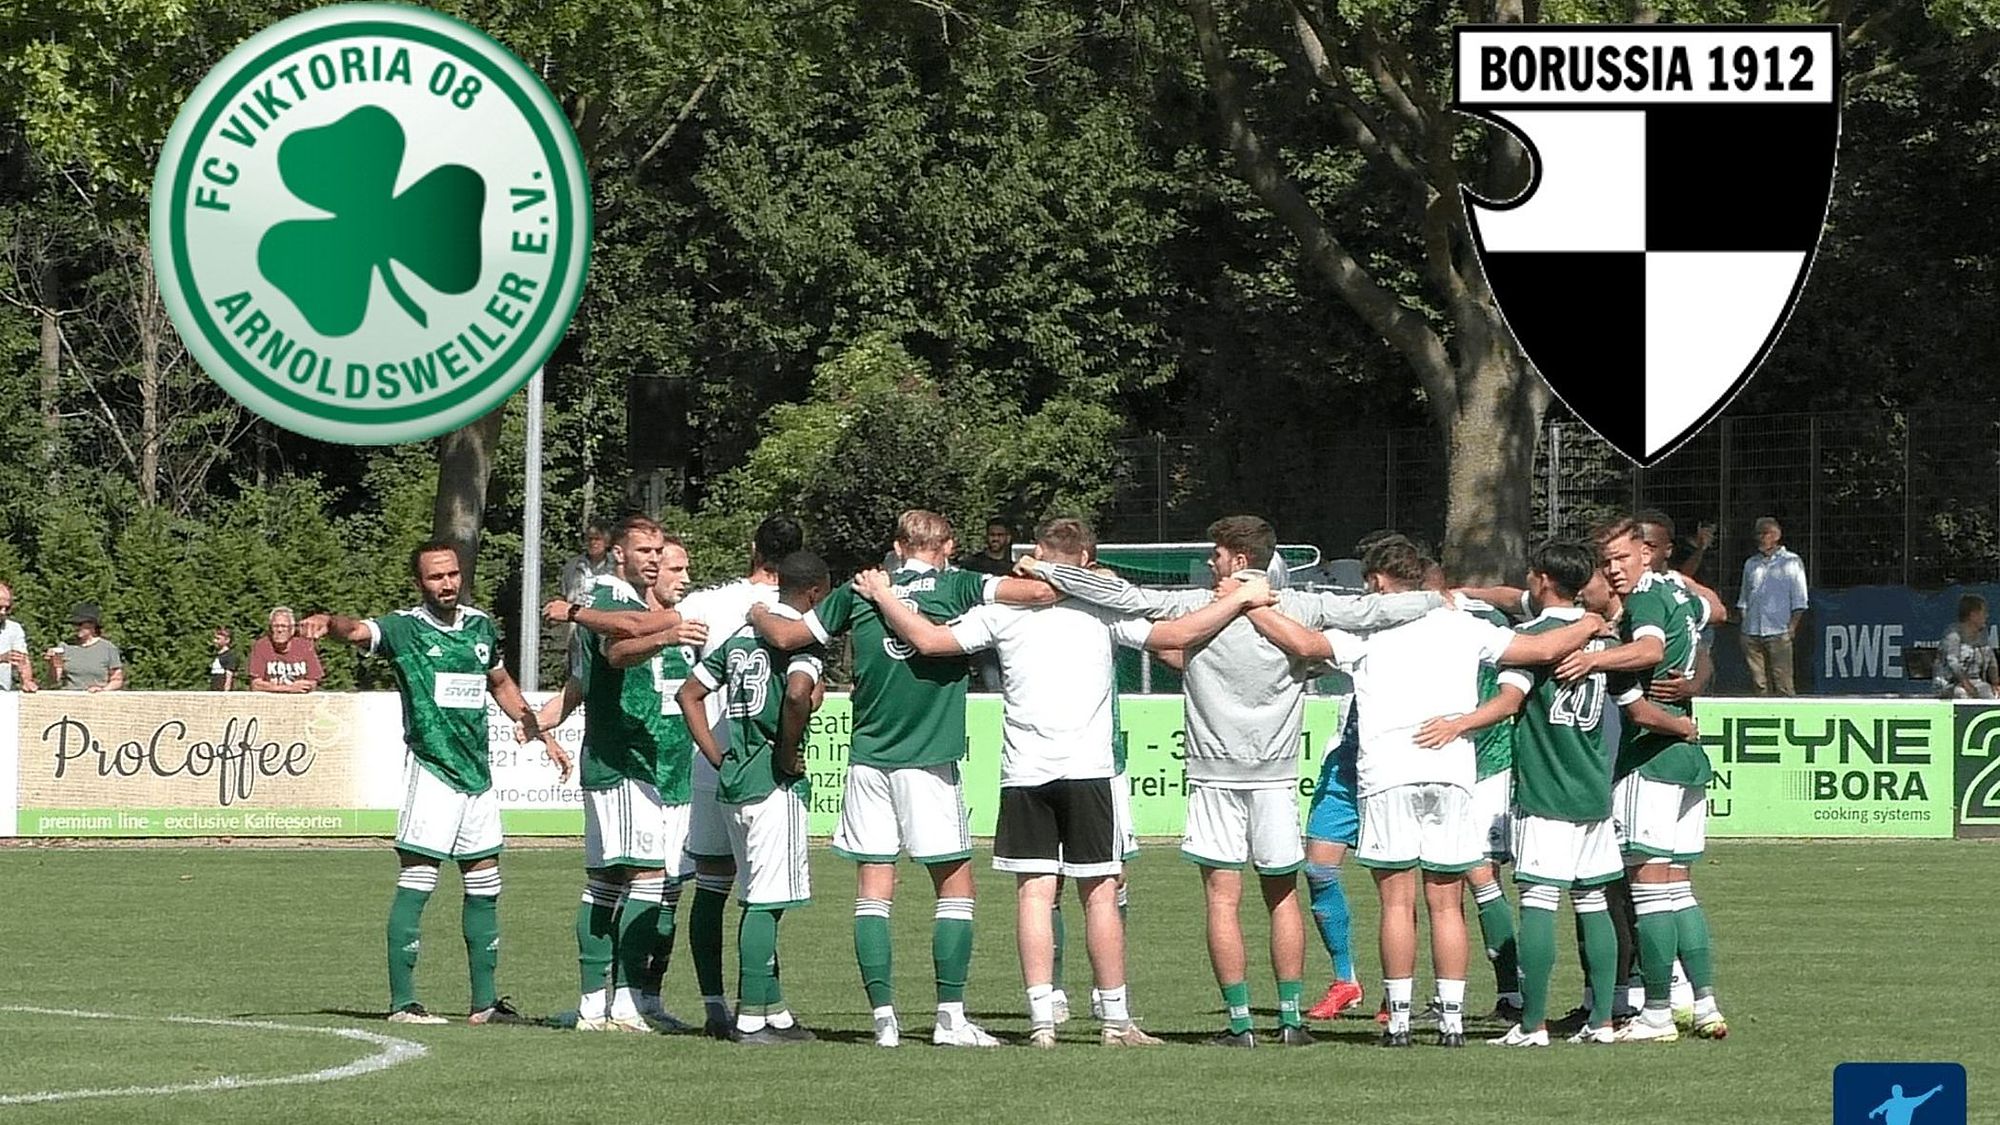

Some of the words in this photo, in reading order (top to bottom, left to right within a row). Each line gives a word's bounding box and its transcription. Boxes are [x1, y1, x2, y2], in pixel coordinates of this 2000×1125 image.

[1824, 624, 1904, 678] RWE
[42, 714, 316, 806] ProCoffee
[1813, 770, 1929, 801] BORA
[39, 815, 114, 834] premium
[118, 812, 149, 830] line
[164, 812, 239, 830] exclusive
[244, 812, 342, 830] Kaffeesorten
[1813, 806, 1869, 824] cooking
[1872, 807, 1931, 823] systems
